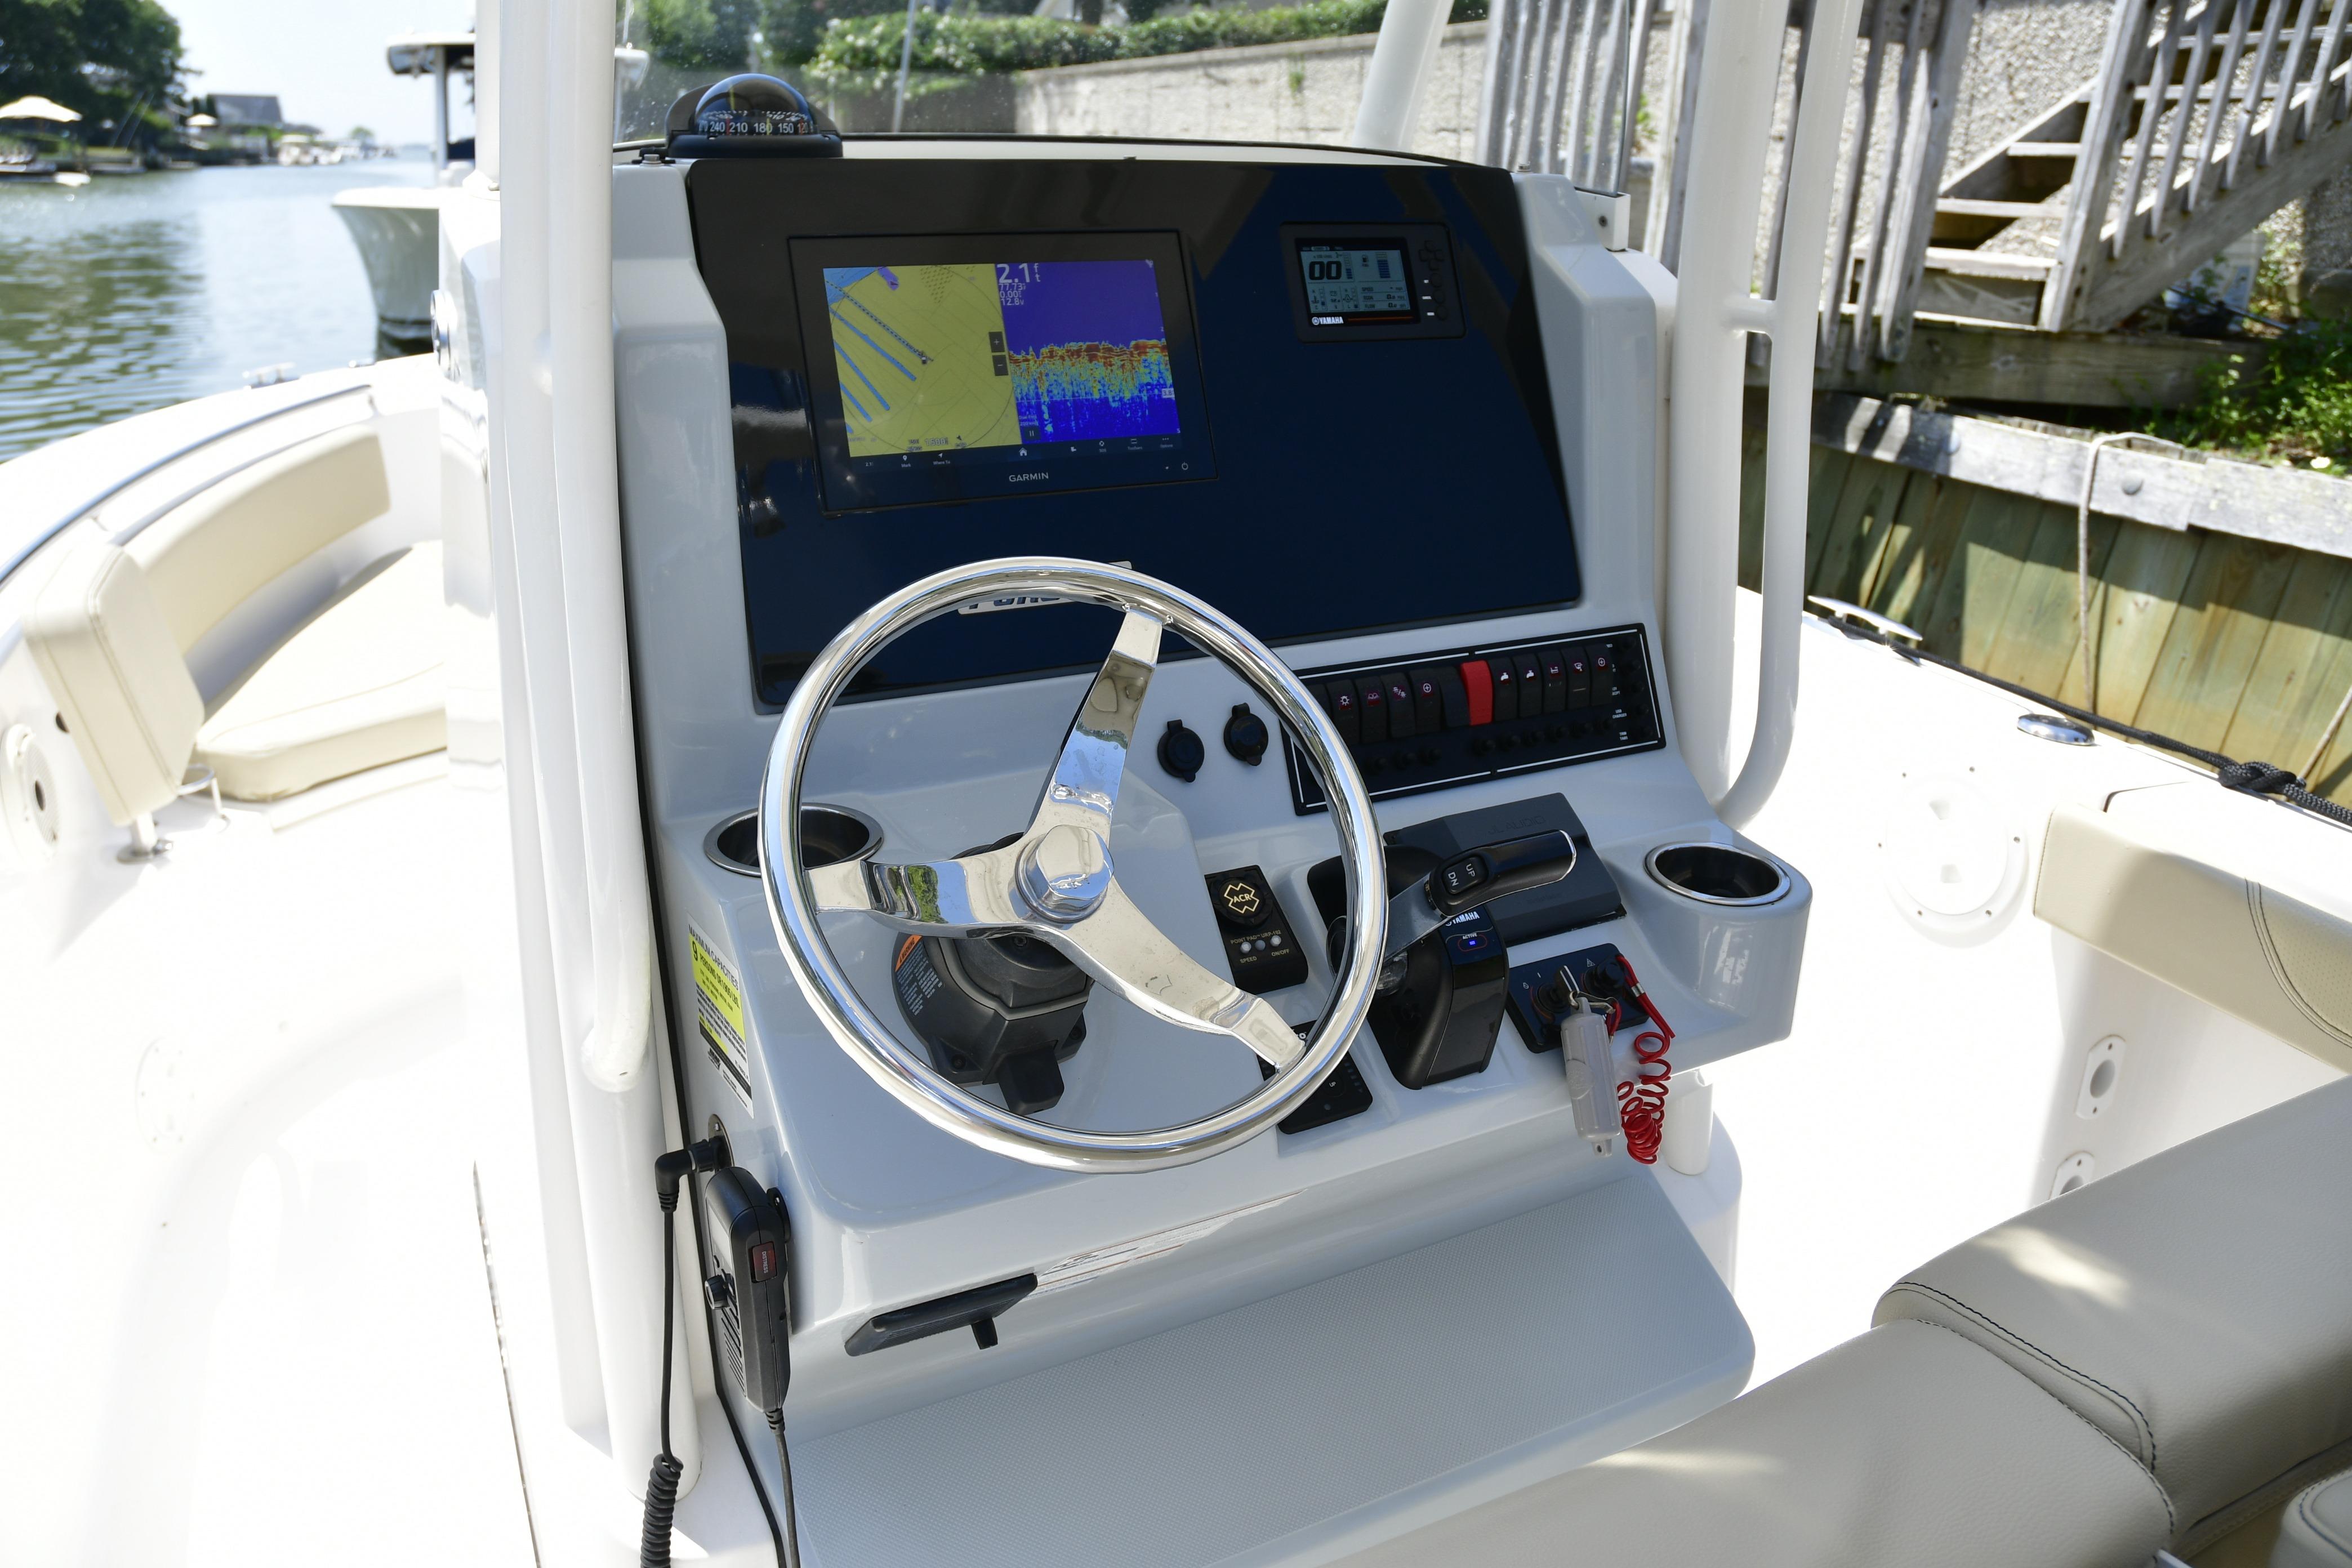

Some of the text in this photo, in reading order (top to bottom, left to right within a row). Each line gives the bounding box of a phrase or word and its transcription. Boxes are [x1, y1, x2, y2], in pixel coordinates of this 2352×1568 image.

[710, 122, 725, 132] 240
[729, 122, 748, 132] 210
[754, 123, 773, 133] 180
[778, 123, 794, 133] 150
[997, 263, 1030, 283] 2.1
[1309, 261, 1342, 280] 00
[1319, 316, 1344, 325] YAMAHA
[1009, 472, 1049, 483] GARMIN
[1505, 816, 1546, 830] AUDIO
[1465, 863, 1476, 877] UP
[1448, 871, 1459, 887] DN
[1233, 893, 1252, 903] ACR
[688, 924, 711, 957] MAXIMUM
[711, 951, 739, 990] CAPACITIES
[692, 941, 698, 961] 9
[1271, 948, 1290, 957] ON/OFF
